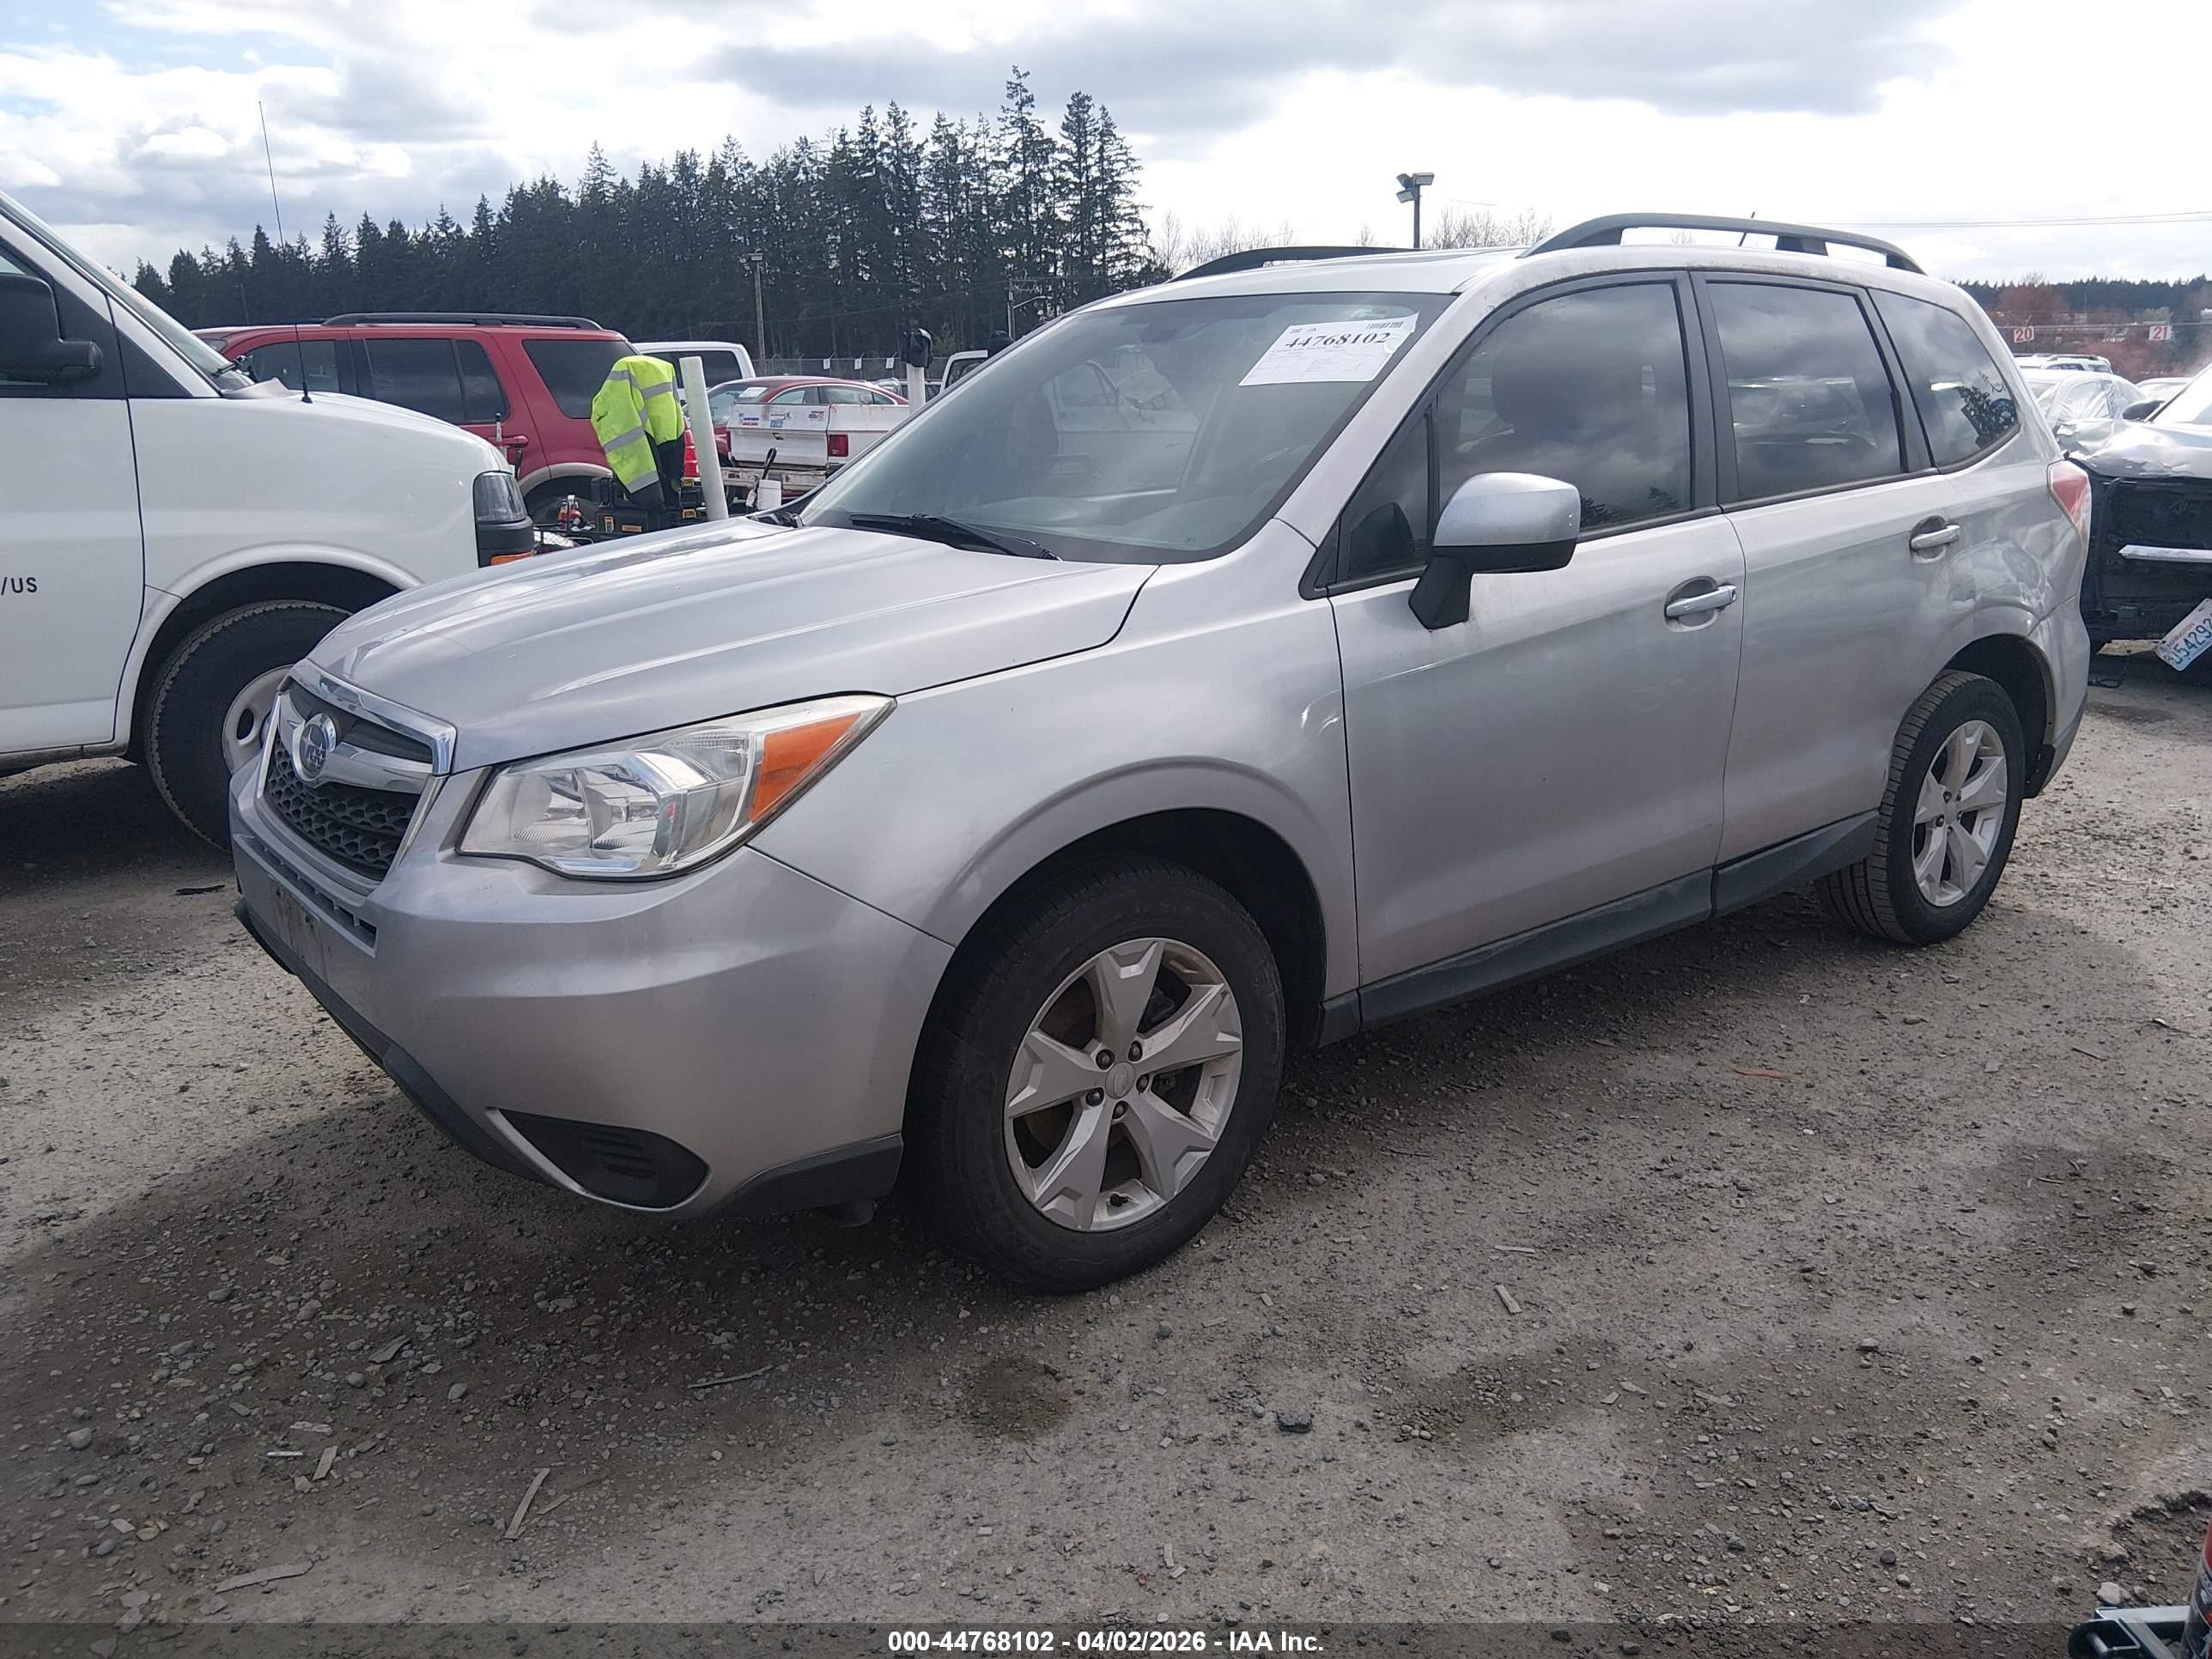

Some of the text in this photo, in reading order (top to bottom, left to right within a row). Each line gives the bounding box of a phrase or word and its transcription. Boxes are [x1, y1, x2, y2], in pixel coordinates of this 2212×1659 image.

[1285, 332, 1391, 348] 44768102
[2015, 328, 2033, 342] 20
[2153, 326, 2168, 340] 21
[1, 576, 38, 596] /US
